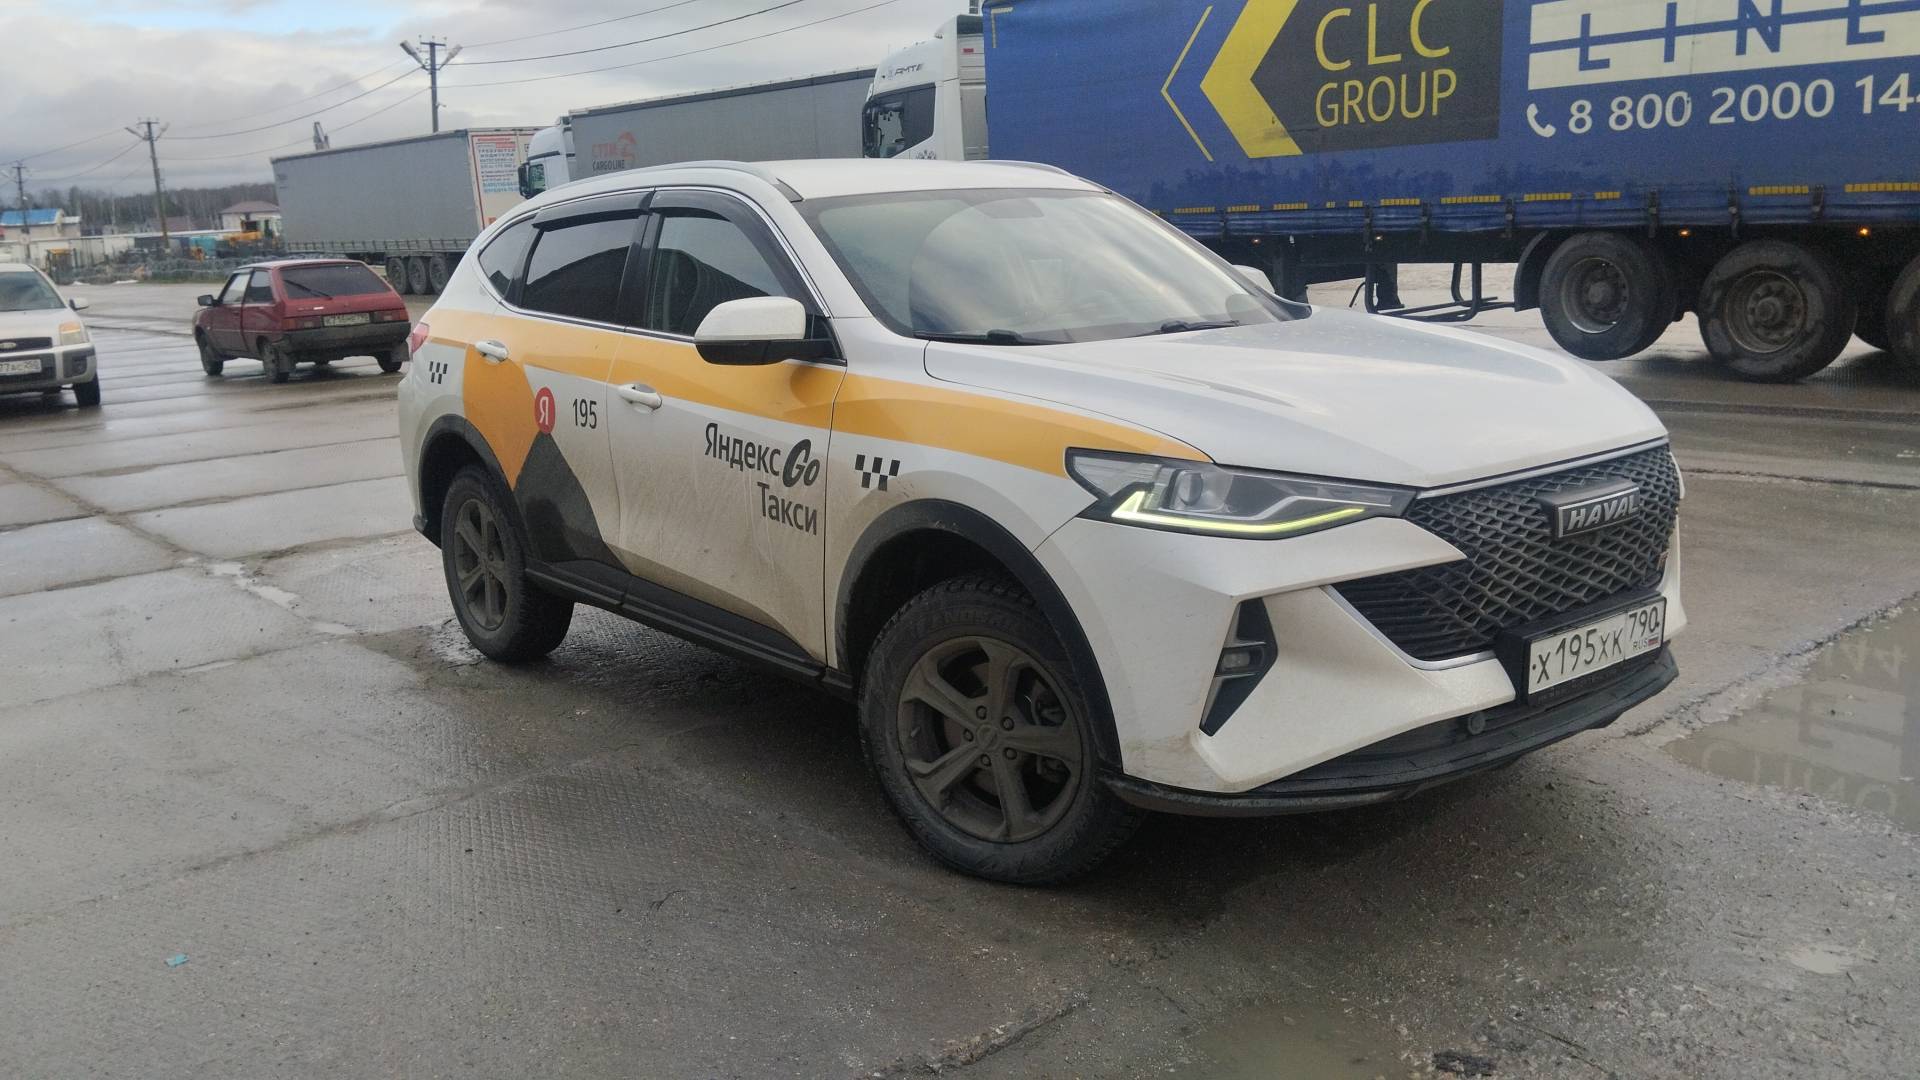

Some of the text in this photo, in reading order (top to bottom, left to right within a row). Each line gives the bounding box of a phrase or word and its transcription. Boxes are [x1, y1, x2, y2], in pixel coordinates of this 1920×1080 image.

[1315, 0, 1450, 71] CLC
[1315, 68, 1457, 127] GROUP
[1568, 72, 1920, 134] 8 800 2000 14
[573, 398, 597, 430] 195
[705, 422, 821, 488] Яндекс Go
[757, 481, 818, 536] Такси
[1567, 494, 1639, 531] HAVAL
[1632, 637, 1648, 651] RUS
